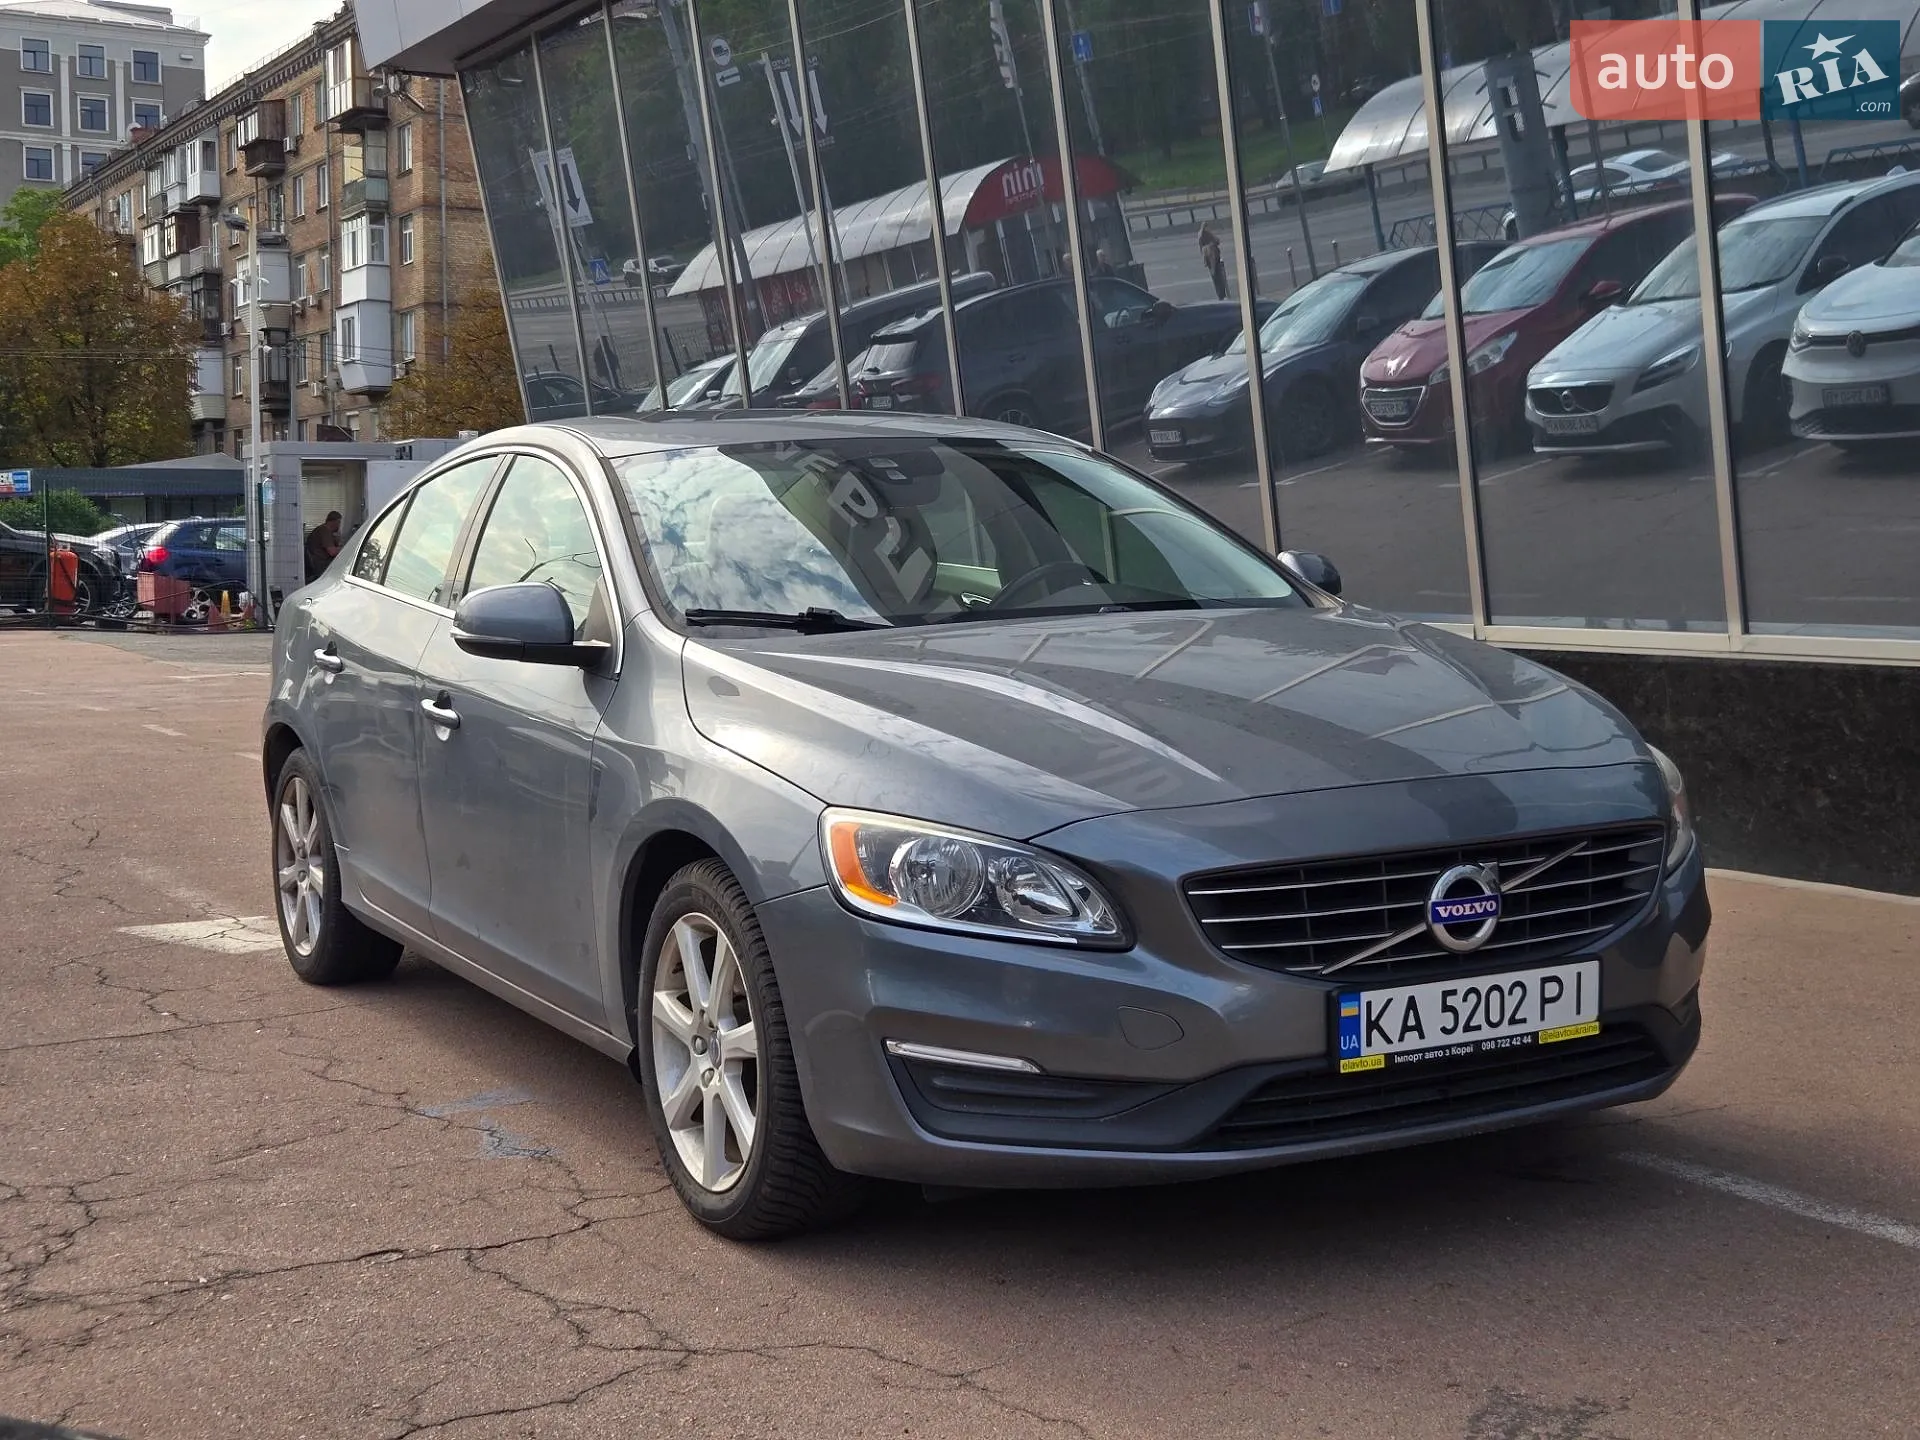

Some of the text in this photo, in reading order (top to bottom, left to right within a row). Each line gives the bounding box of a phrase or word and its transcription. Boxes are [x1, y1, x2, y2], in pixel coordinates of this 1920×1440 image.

[1435, 900, 1497, 918] VOLVO
[1365, 971, 1582, 1048] KA 5202 PI
[1340, 1033, 1359, 1050] UA
[1424, 1049, 1443, 1060] авто
[1497, 1037, 1511, 1049] 722
[1511, 1036, 1521, 1047] 42
[1522, 1034, 1532, 1044] 44
